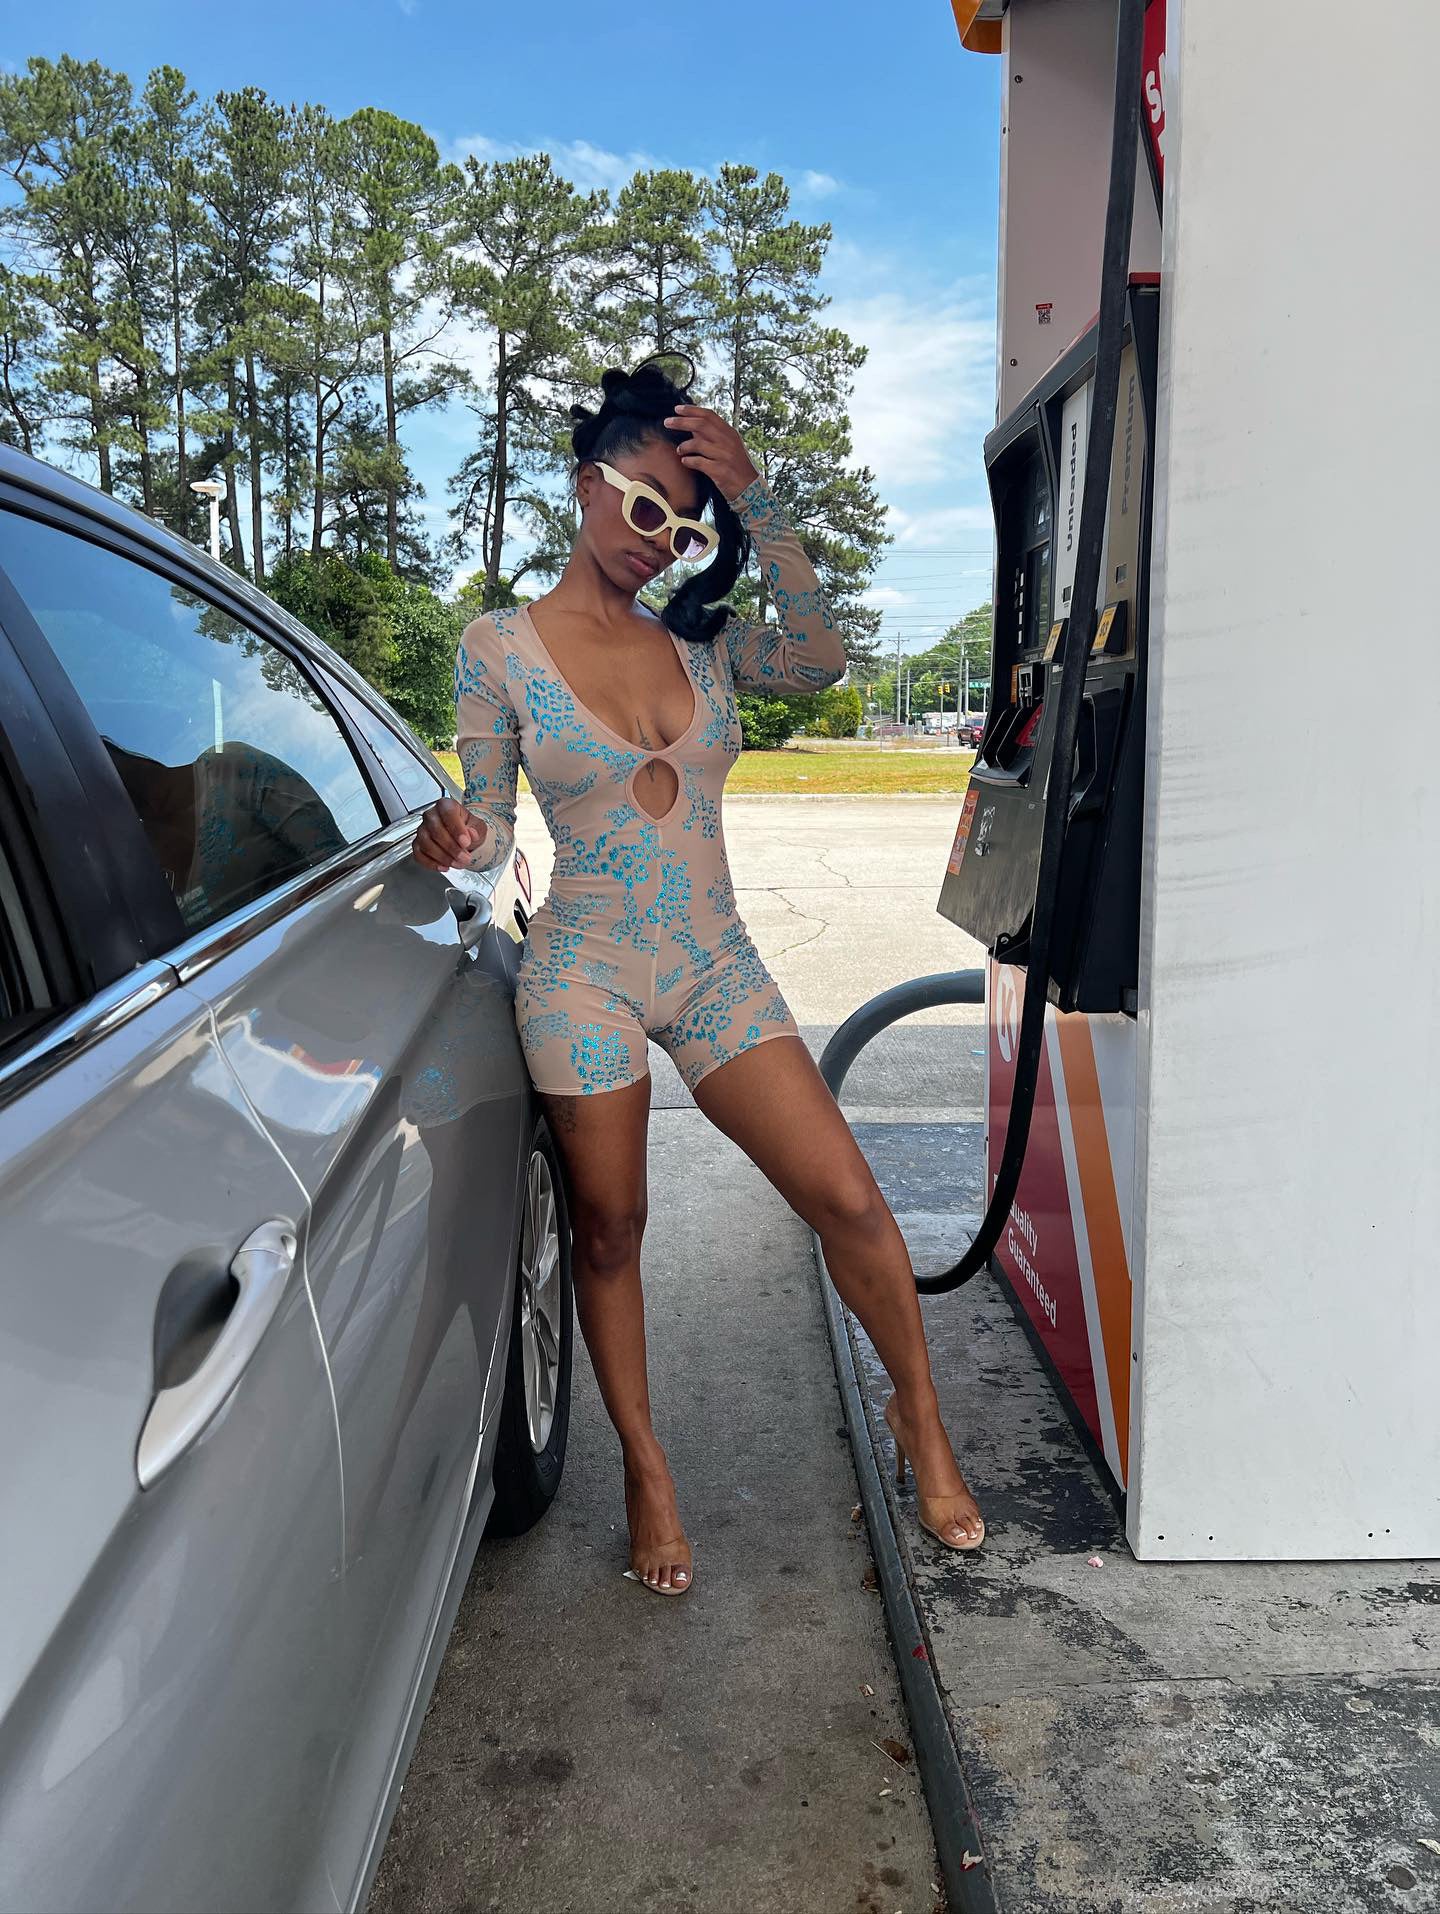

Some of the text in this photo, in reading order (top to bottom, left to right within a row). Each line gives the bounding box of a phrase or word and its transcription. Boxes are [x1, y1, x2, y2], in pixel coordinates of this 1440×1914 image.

[1066, 421, 1078, 552] Unleaded
[1121, 374, 1136, 516] Premium
[1007, 1226, 1058, 1329] Guaranteed
